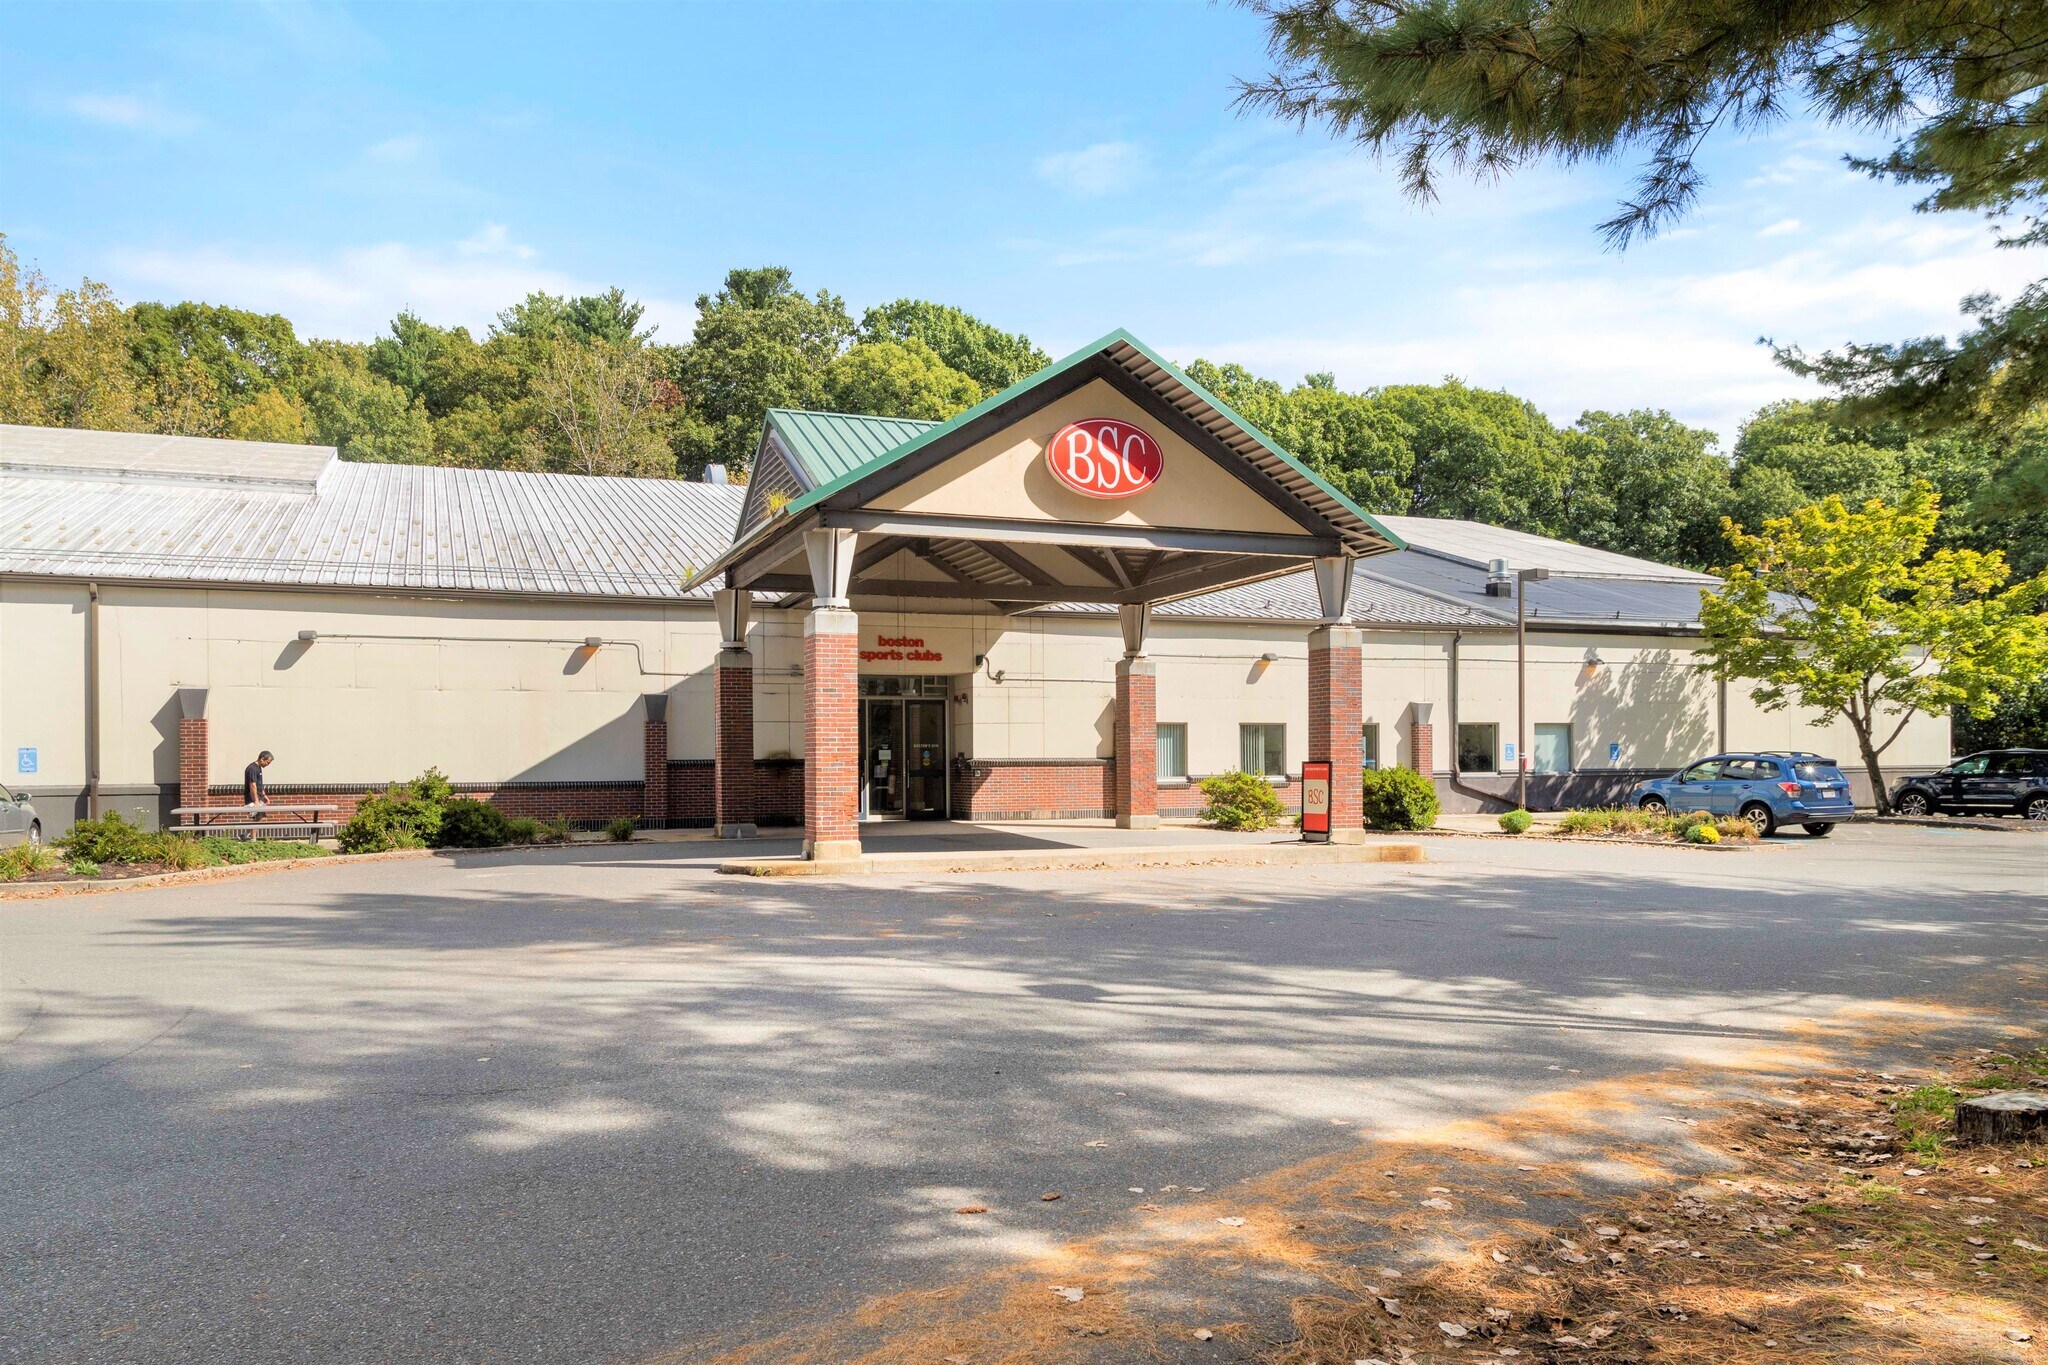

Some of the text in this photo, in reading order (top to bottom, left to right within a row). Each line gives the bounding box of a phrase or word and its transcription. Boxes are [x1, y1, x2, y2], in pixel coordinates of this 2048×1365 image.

[1066, 426, 1147, 489] BSC
[878, 635, 925, 648] boston
[859, 649, 943, 662] sports clubs
[1307, 788, 1324, 805] BSC
